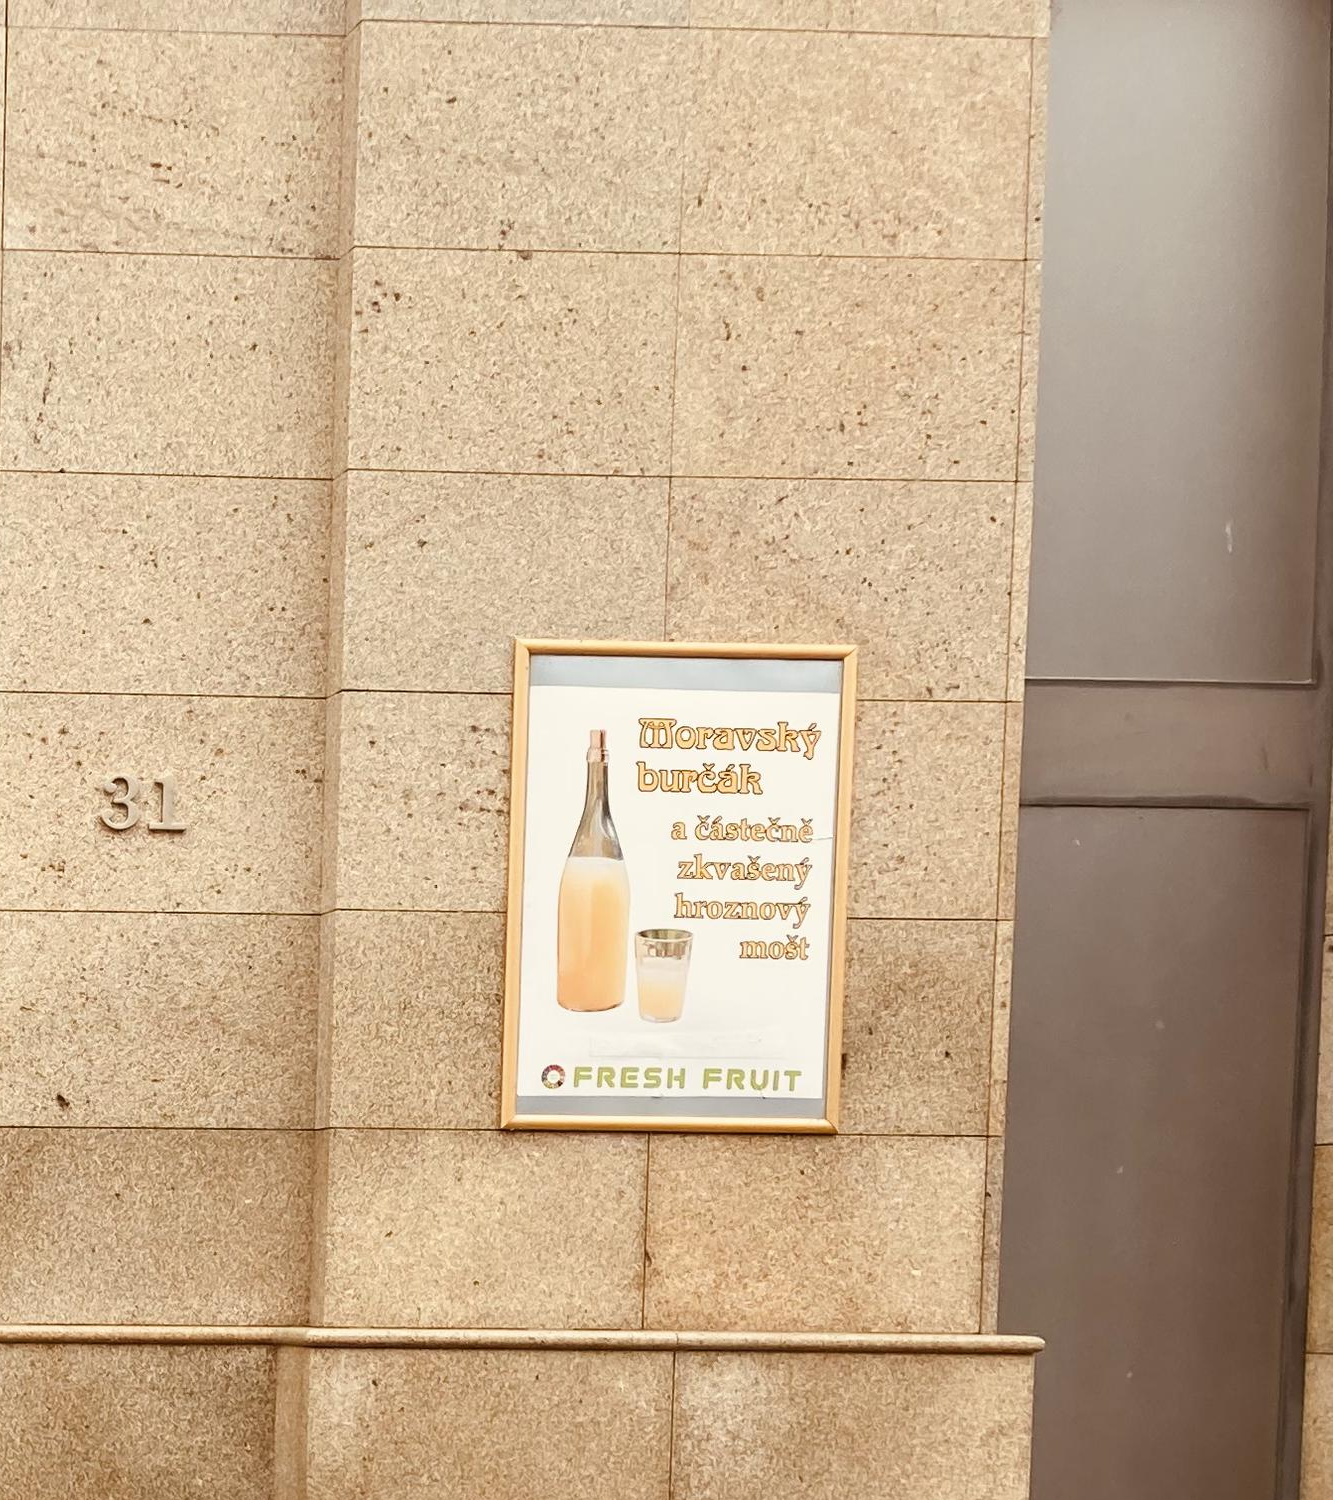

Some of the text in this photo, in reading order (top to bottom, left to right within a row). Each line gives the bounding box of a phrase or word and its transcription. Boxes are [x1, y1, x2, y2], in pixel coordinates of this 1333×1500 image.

[639, 717, 822, 759] Moravský
[636, 762, 763, 795] burčák
[100, 776, 188, 832] 31
[671, 815, 814, 844] a částečně
[677, 855, 813, 890] zkvašený
[673, 892, 811, 929] hroznový
[739, 934, 809, 962] mošt
[573, 1066, 802, 1092] FRESH FRUIT
